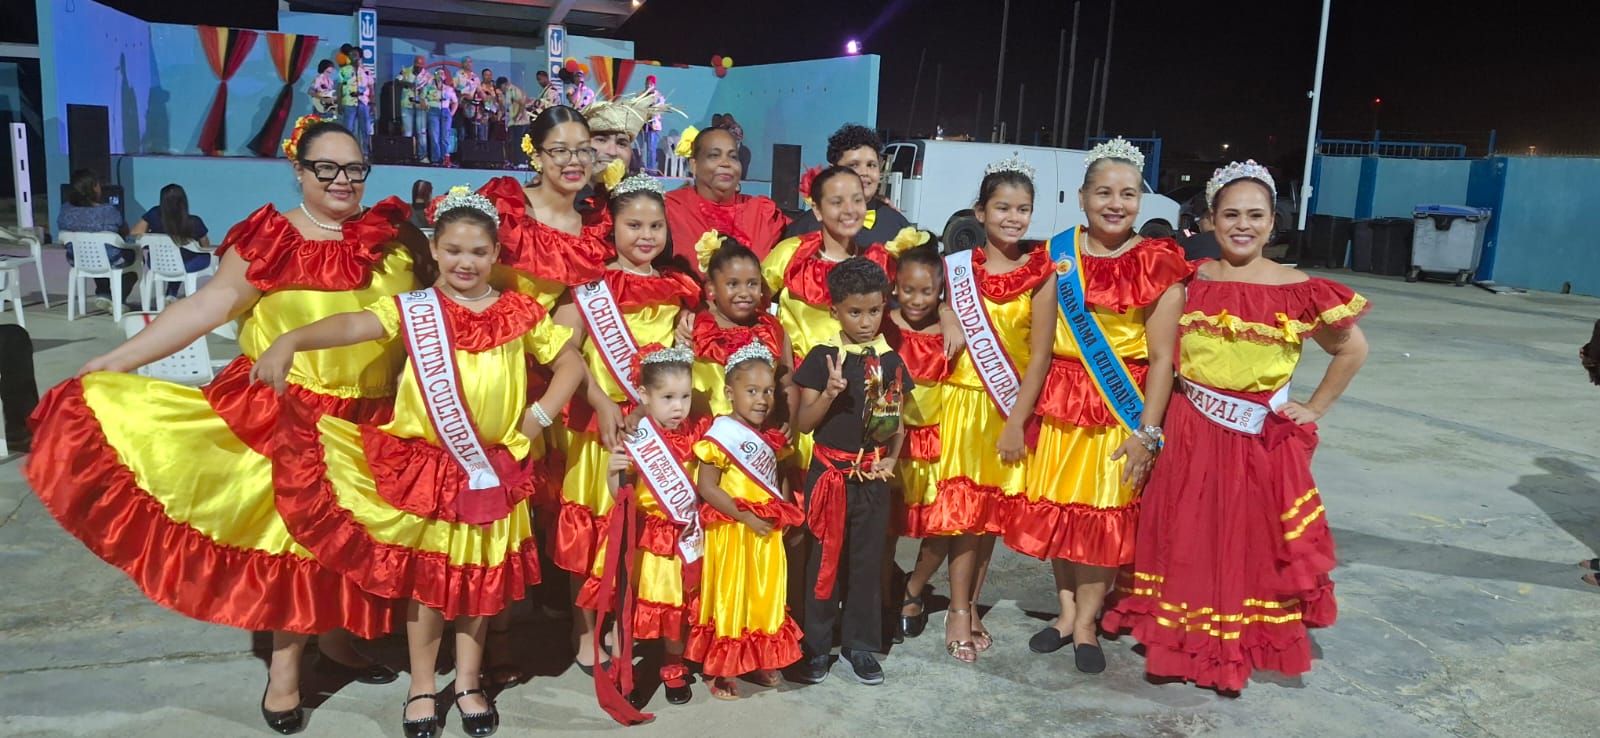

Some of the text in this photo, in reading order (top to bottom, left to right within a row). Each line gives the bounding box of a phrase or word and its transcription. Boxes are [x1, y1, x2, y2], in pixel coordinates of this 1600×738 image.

[588, 296, 634, 364] CHIKITIN
[954, 277, 984, 338] PRENDA
[972, 337, 1018, 407] CULTURAL
[1058, 281, 1080, 316] GRAN
[1072, 313, 1098, 348] DAMA
[1092, 350, 1130, 405] CULTURAL
[408, 303, 448, 379] CHIKITIN
[429, 378, 480, 462] CULTURAL
[1184, 381, 1238, 423] NAVAL
[637, 438, 663, 463] MI
[648, 461, 669, 488] WOWO
[751, 450, 776, 480] BABY
